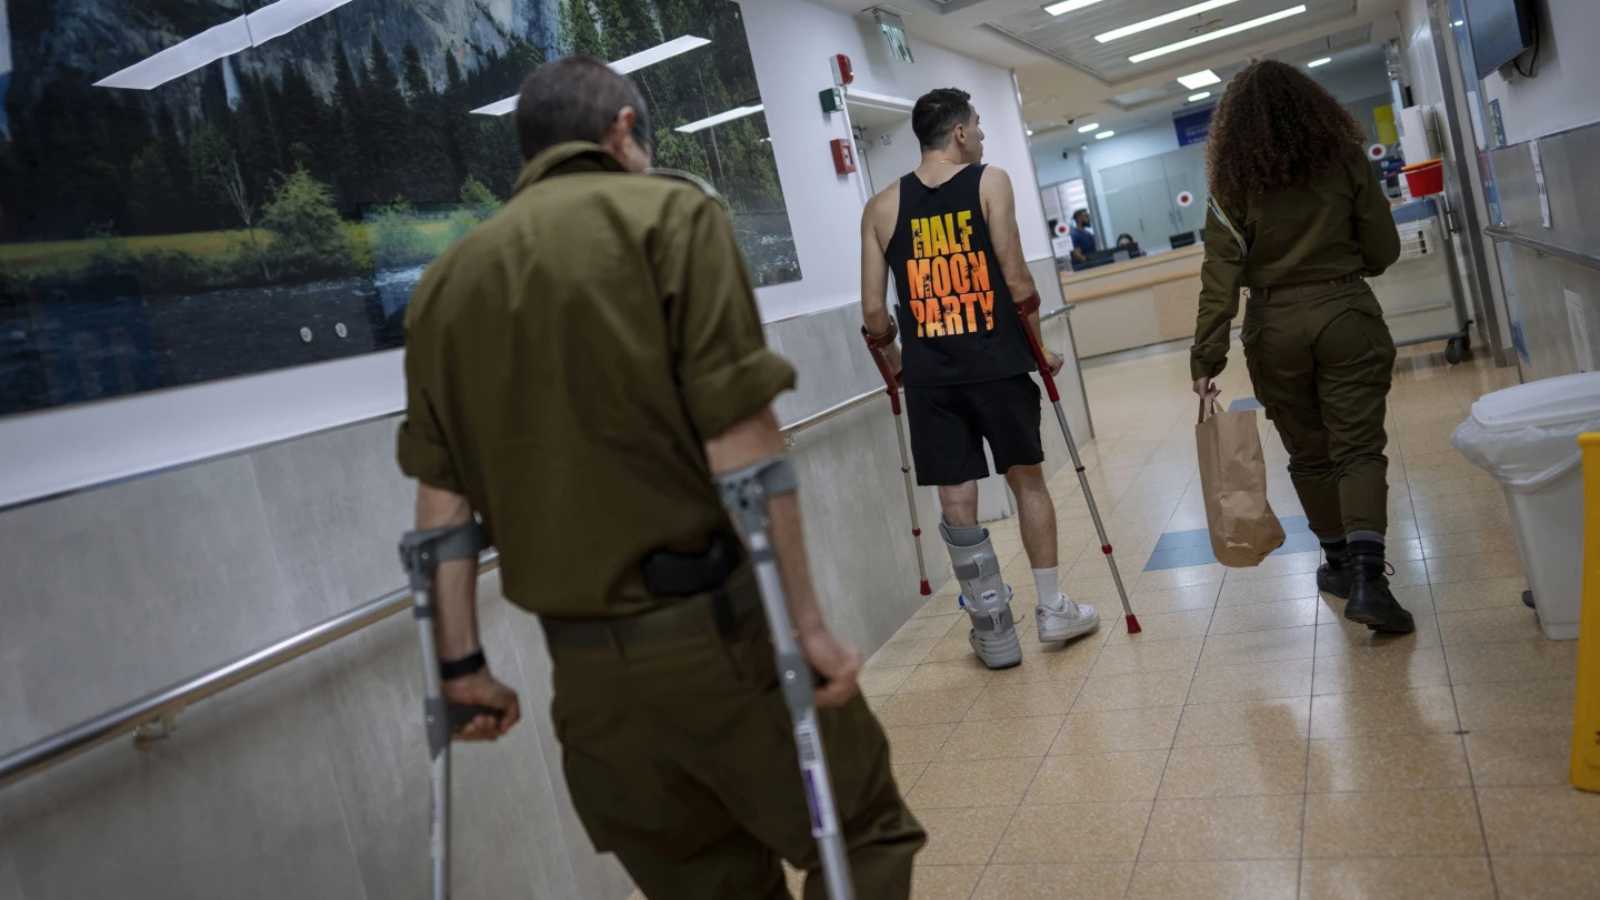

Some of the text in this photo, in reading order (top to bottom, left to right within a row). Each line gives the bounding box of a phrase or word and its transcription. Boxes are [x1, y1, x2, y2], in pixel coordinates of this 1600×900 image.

[911, 210, 972, 258] HALF
[906, 250, 990, 299] MOON
[909, 291, 994, 337] PARTY
